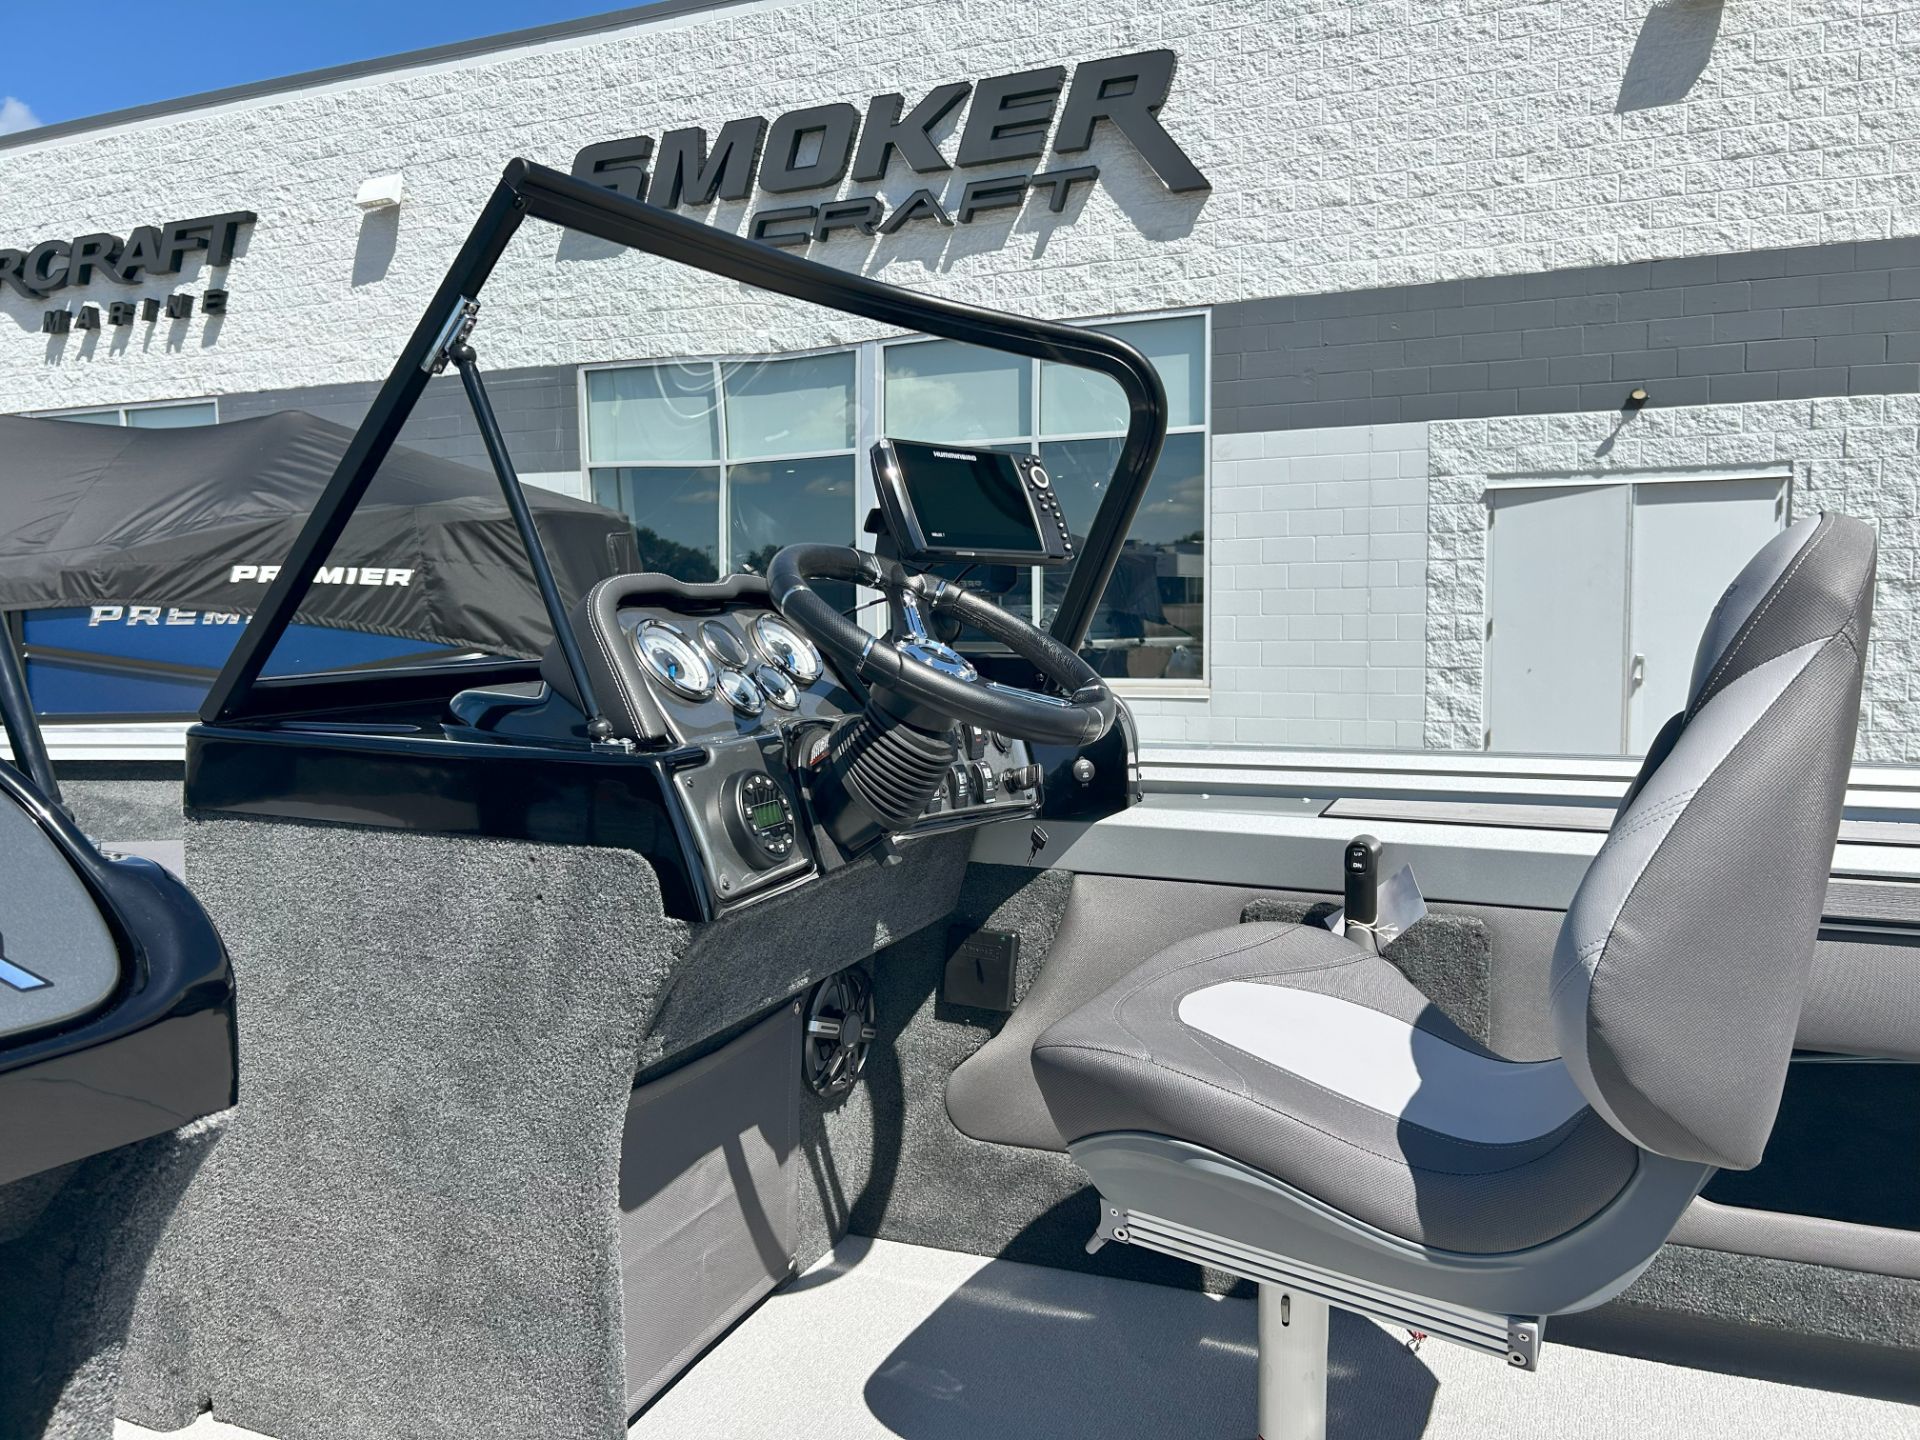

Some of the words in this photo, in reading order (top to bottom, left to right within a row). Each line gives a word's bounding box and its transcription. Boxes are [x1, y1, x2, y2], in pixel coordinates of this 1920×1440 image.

[571, 49, 1211, 210] SMOKER
[749, 165, 1099, 246] CRAFT
[42, 289, 228, 334] MARINE
[229, 564, 415, 587] PRMIER
